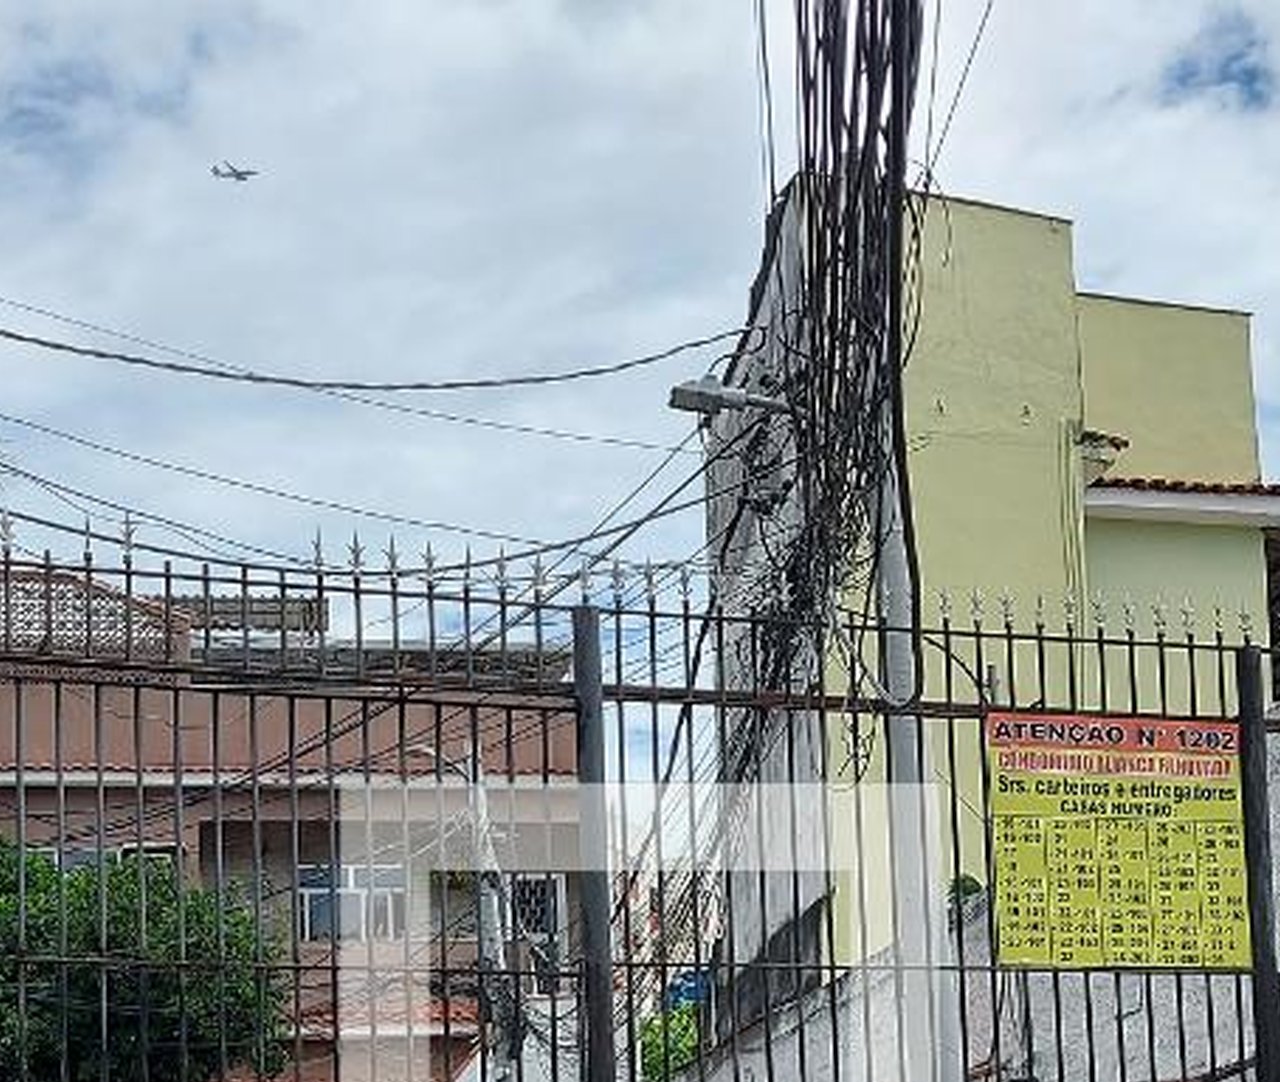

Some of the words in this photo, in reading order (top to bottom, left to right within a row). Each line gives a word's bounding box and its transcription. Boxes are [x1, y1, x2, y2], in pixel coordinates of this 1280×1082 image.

[1176, 728, 1235, 750] 1202
[1035, 777, 1111, 797] carteiros
[1130, 781, 1237, 803] entregadores
